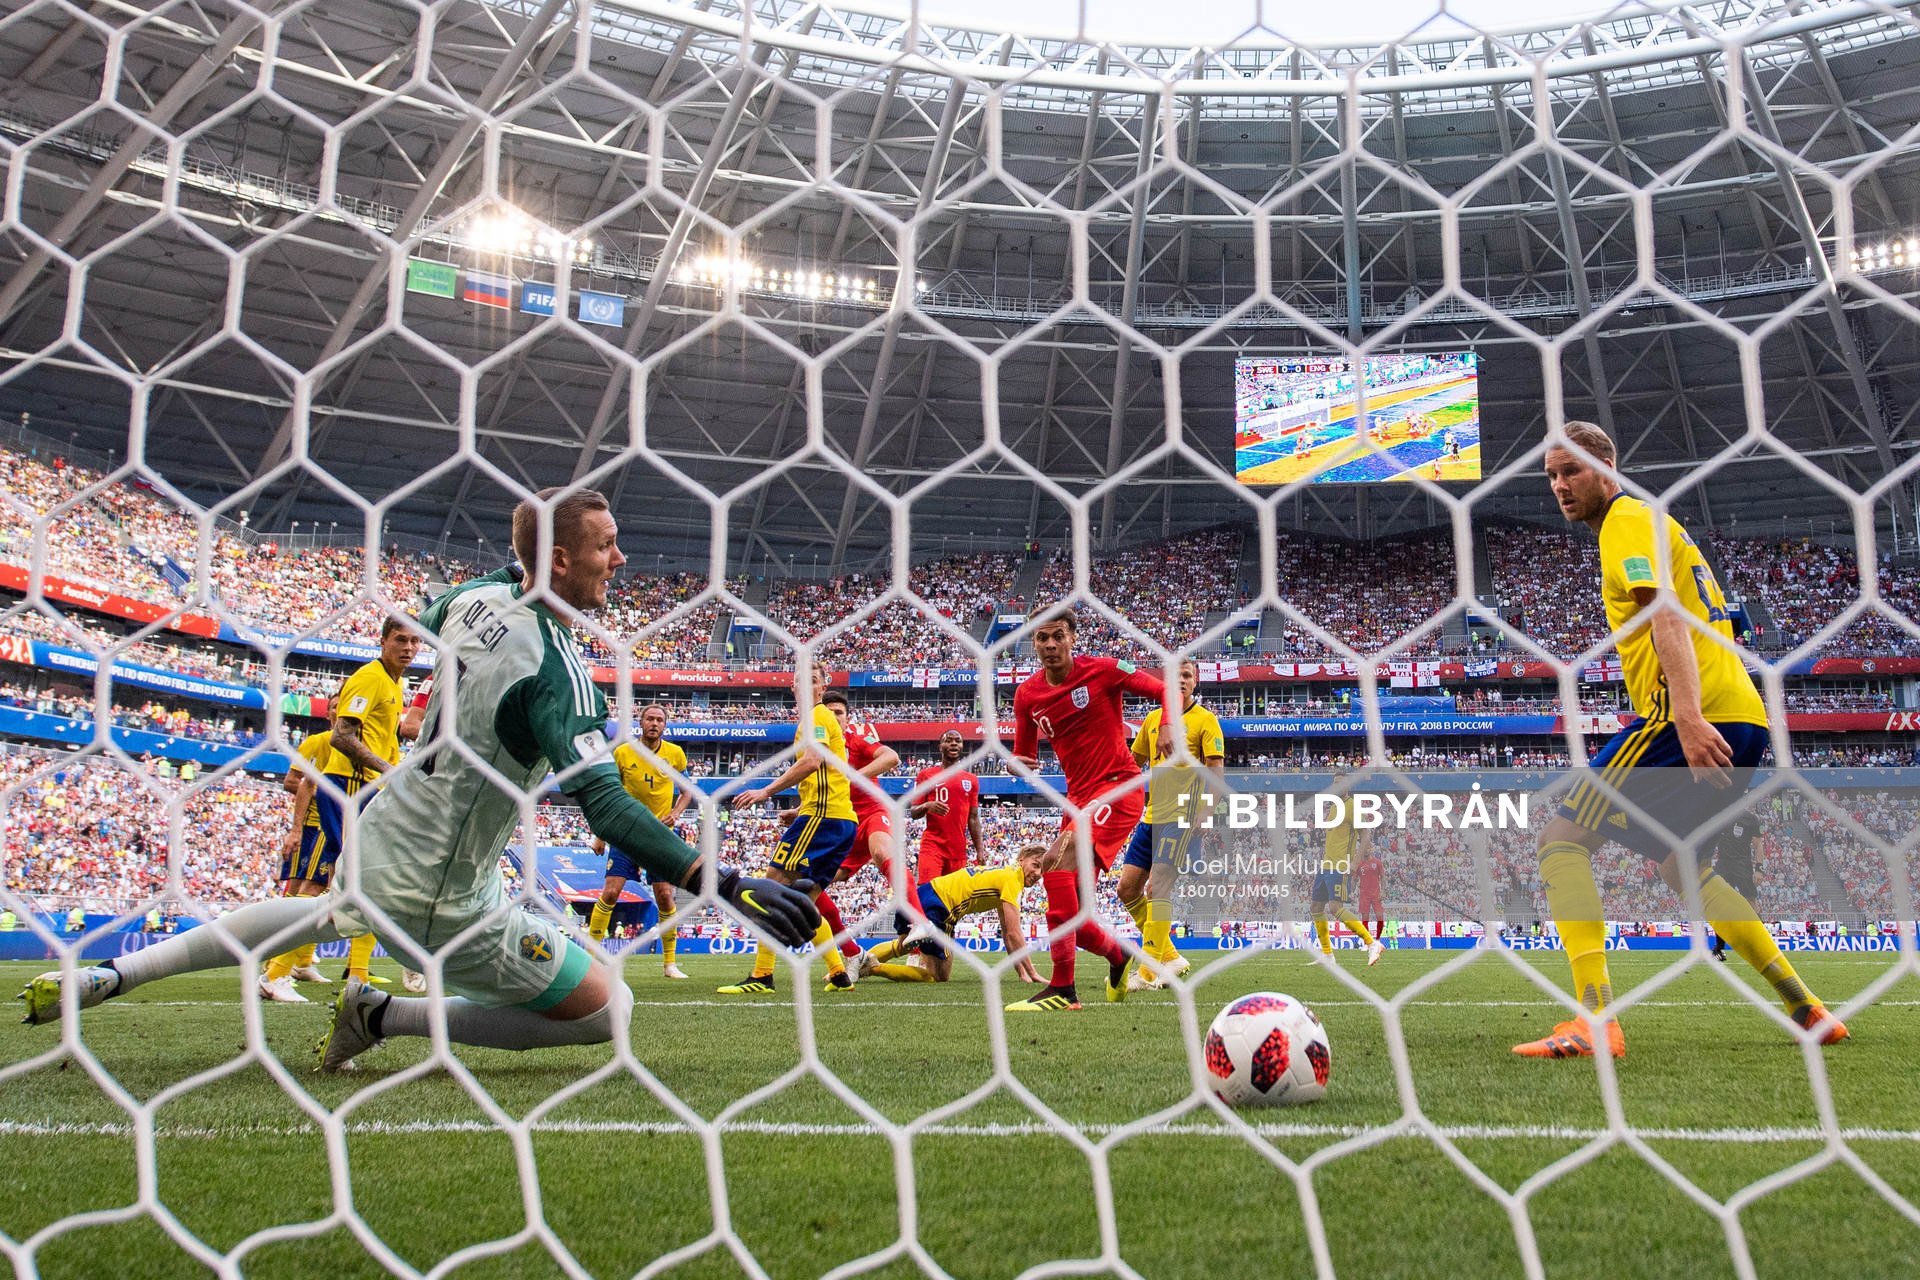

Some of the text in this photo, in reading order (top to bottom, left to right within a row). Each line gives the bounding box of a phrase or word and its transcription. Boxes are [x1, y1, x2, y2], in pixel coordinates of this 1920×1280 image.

[528, 292, 558, 307] FIFA
[1257, 366, 1274, 374] SWE
[296, 640, 322, 652] МИРА
[324, 643, 338, 654] ПО
[671, 672, 722, 684] #worldcup
[958, 673, 972, 682] ПО
[677, 727, 709, 737] WORLD
[709, 727, 730, 737] CUP
[731, 728, 767, 737] RUSSIA
[1242, 721, 1492, 732] ЧЕМПИОНАТ МИРА ПО ФУТОЛУ FIFA 2018 В РОССИИ
[644, 773, 655, 788] 4
[936, 787, 949, 802] 10
[1157, 837, 1177, 860] 17
[1334, 885, 1342, 897] 9
[1505, 937, 1549, 950] 万达
[1815, 936, 1897, 951] WANDA
